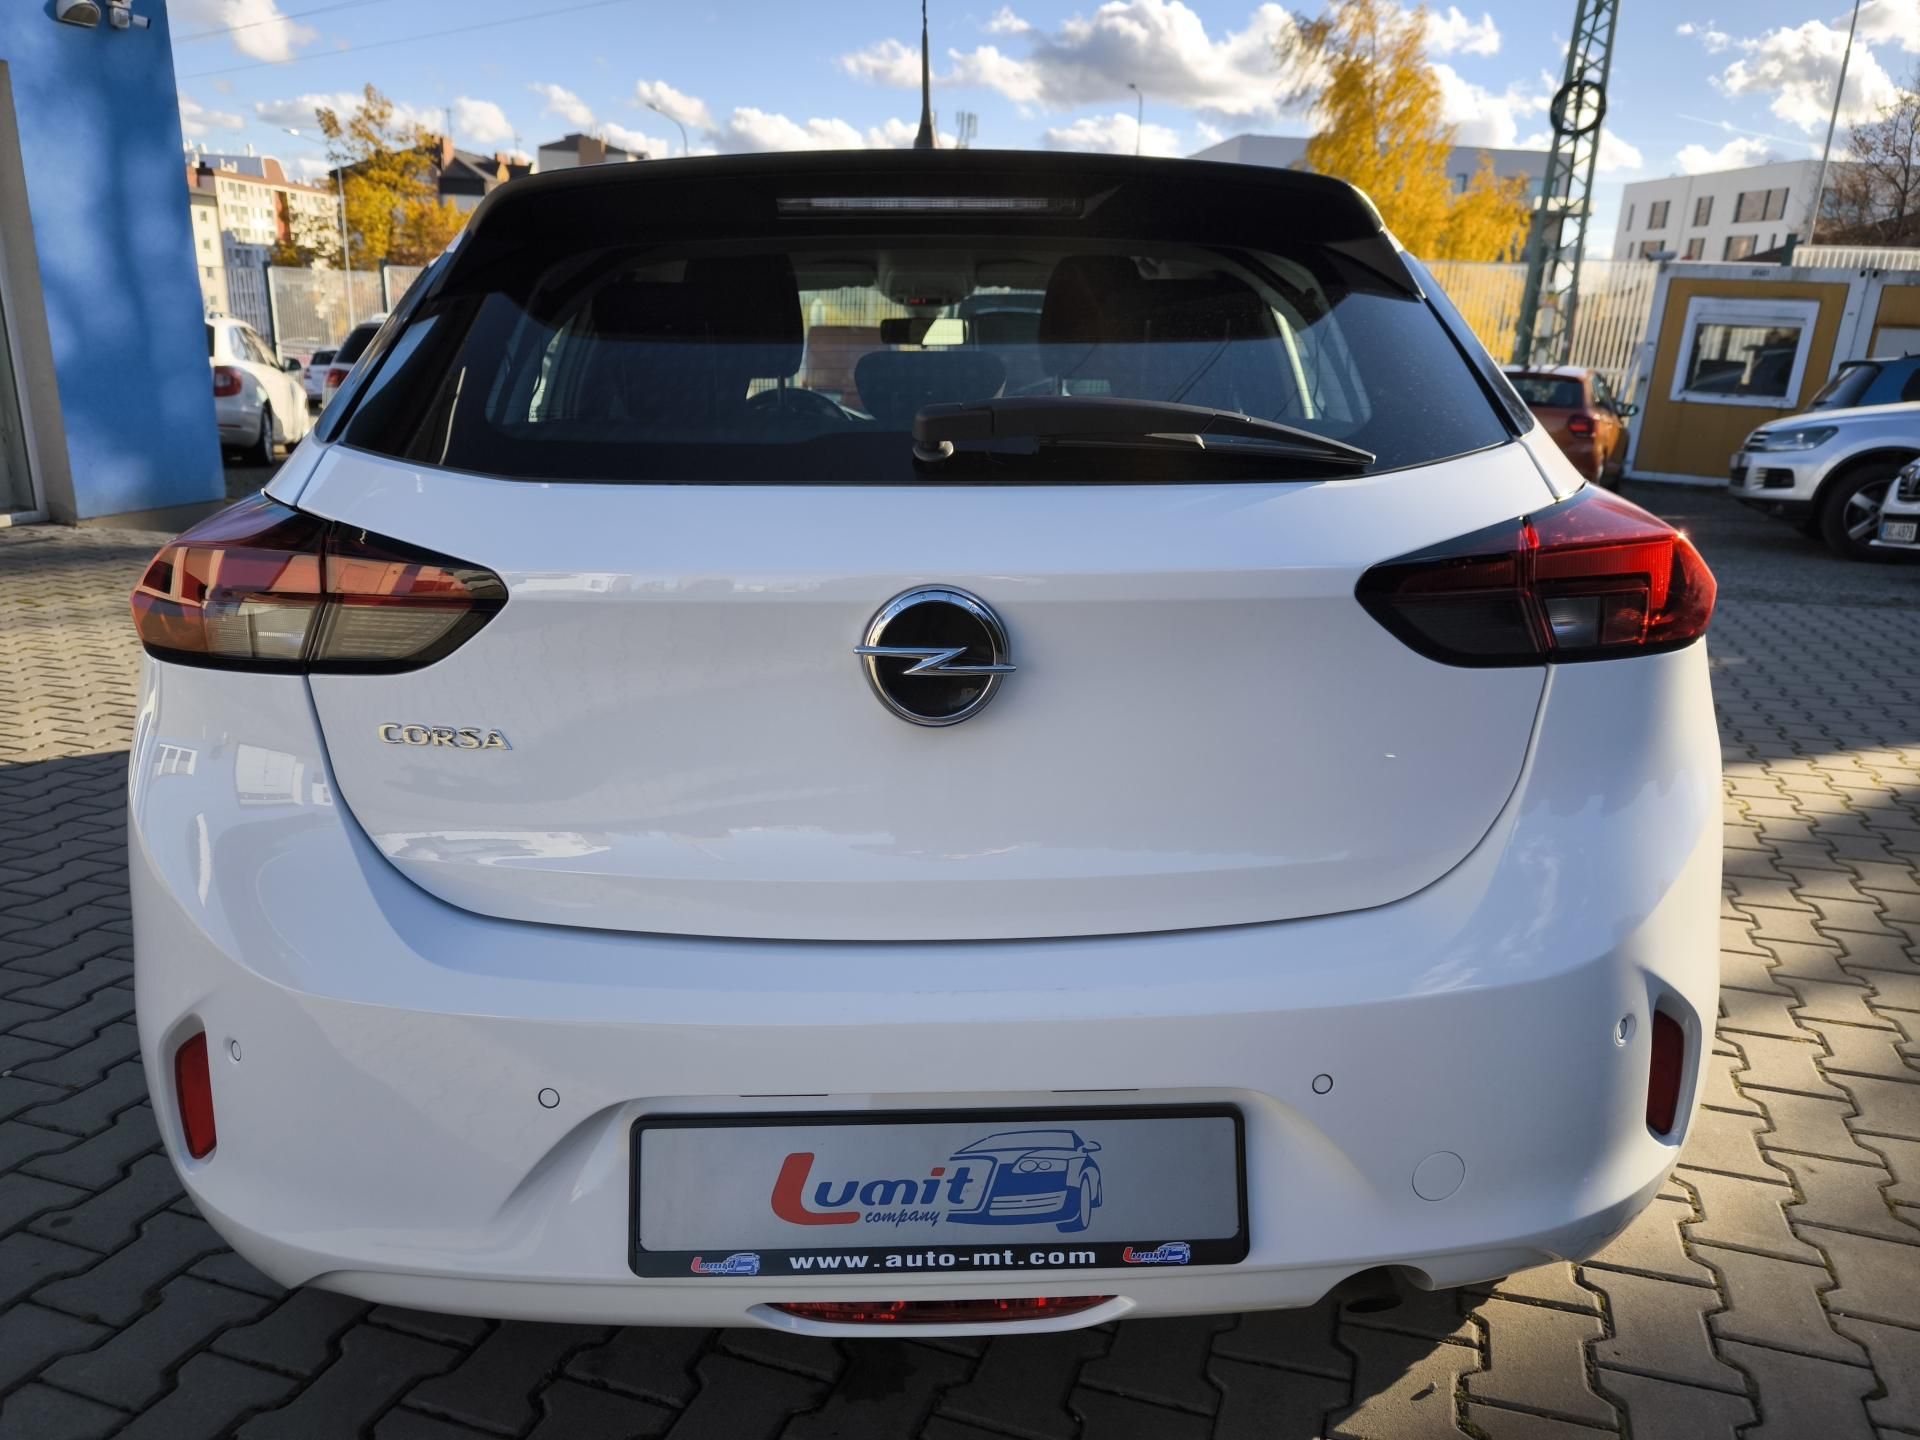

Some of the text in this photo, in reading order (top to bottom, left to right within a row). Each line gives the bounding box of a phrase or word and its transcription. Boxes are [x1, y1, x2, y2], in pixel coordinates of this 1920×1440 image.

[378, 722, 512, 750] CORSA
[771, 1152, 973, 1225] Lumit
[865, 1208, 940, 1228] company
[789, 1249, 1096, 1270] www.auto-mt.com
